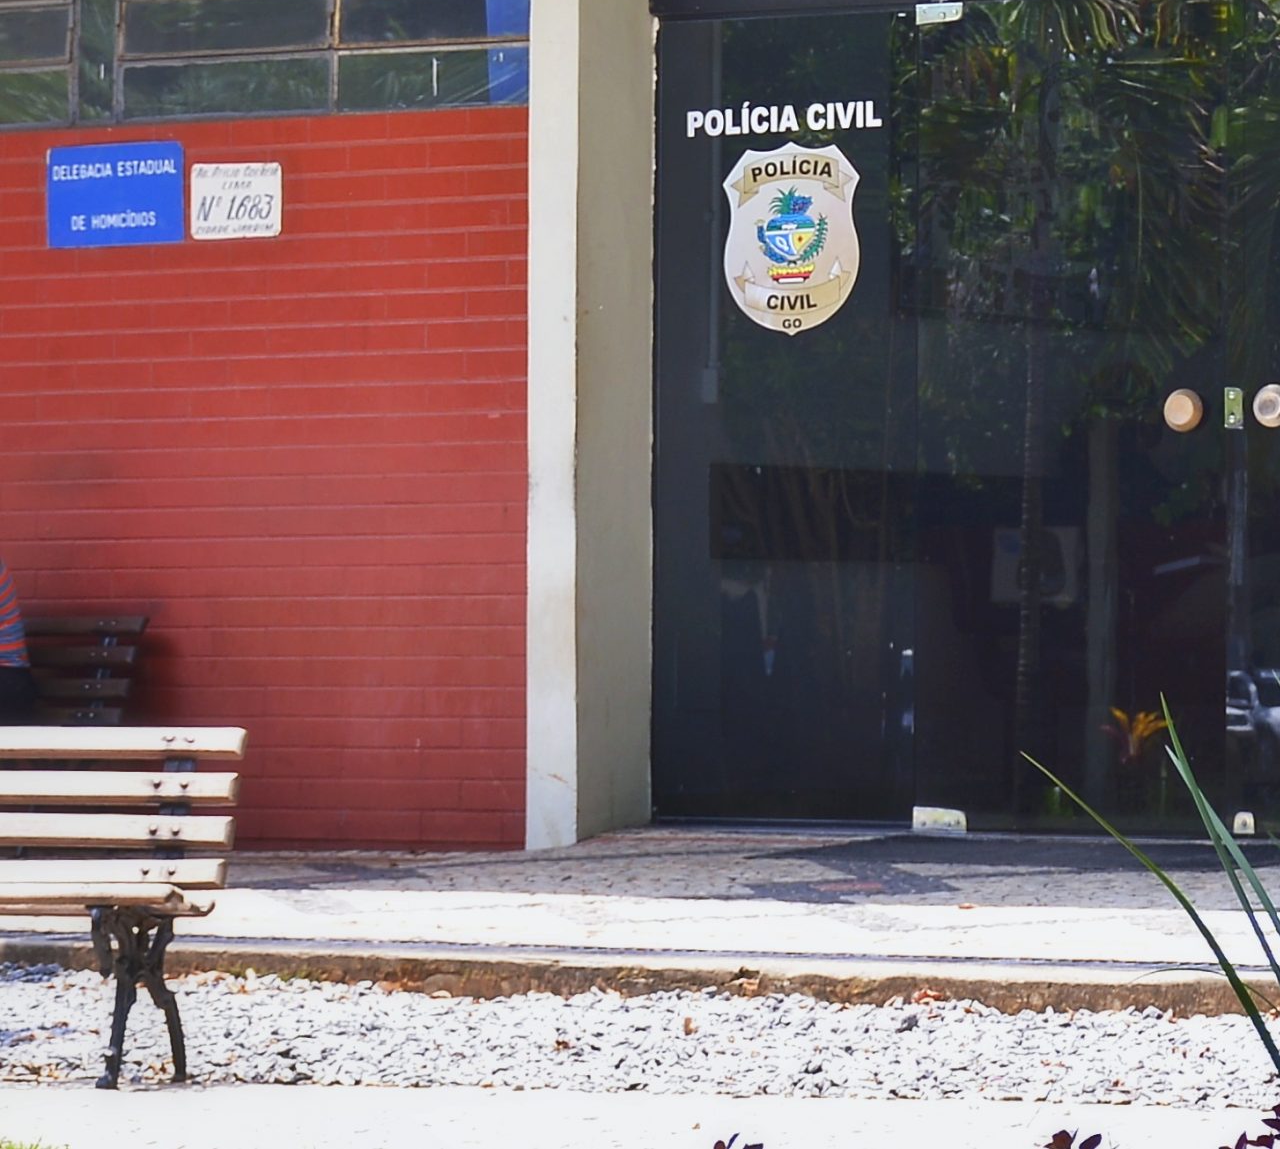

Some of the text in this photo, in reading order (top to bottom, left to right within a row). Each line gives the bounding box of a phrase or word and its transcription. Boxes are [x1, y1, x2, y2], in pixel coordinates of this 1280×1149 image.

[686, 100, 883, 138] POLÍCIA CIVIL
[52, 162, 113, 181] DELEGACIA
[117, 159, 177, 177] ESTADUAL
[751, 156, 833, 183] POLÍCIA
[71, 209, 157, 231] DE HOMICÍDIOS
[766, 294, 818, 311] CIVIL
[782, 318, 802, 329] GO
